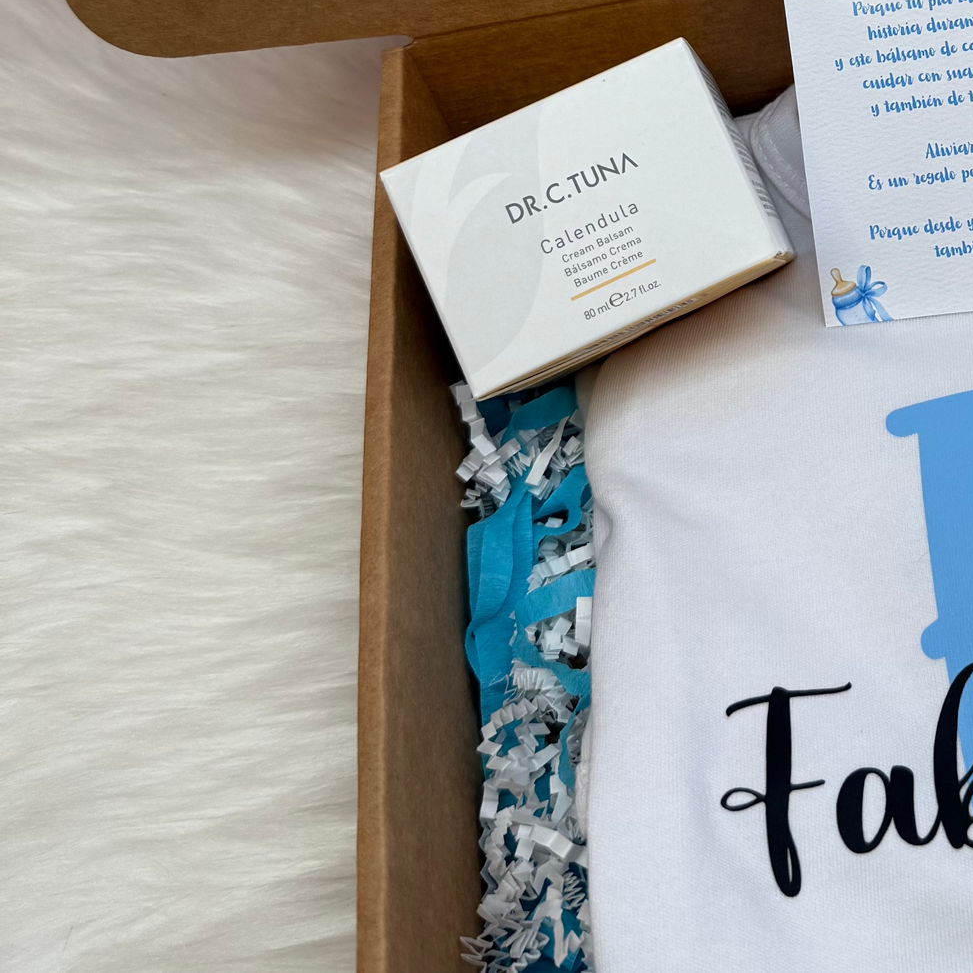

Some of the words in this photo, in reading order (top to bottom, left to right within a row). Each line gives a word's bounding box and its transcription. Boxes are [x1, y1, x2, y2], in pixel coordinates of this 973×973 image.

[852, 2, 902, 16] Porque
[867, 24, 922, 40] historia
[834, 59, 844, 71] y
[849, 54, 872, 67] este
[876, 47, 935, 63] bálsamo
[940, 41, 957, 57] de
[862, 74, 914, 90] cuidar
[918, 72, 942, 84] con
[870, 104, 880, 117] y
[884, 96, 943, 114] también
[947, 91, 965, 106] de
[868, 174, 883, 191] Es
[888, 177, 909, 188] un
[913, 168, 956, 185] regalo
[540, 201, 639, 255] Calendula
[869, 224, 920, 240] Porque
[923, 217, 963, 235] desde
[561, 244, 595, 263] Cream
[596, 225, 634, 248] Balsam
[564, 253, 608, 277] Bálsamo
[608, 236, 642, 255] Crema
[573, 266, 609, 288] Baume
[609, 250, 644, 271] Crème
[583, 308, 597, 320] 80
[597, 301, 611, 315] ml
[623, 287, 638, 302] 2.7
